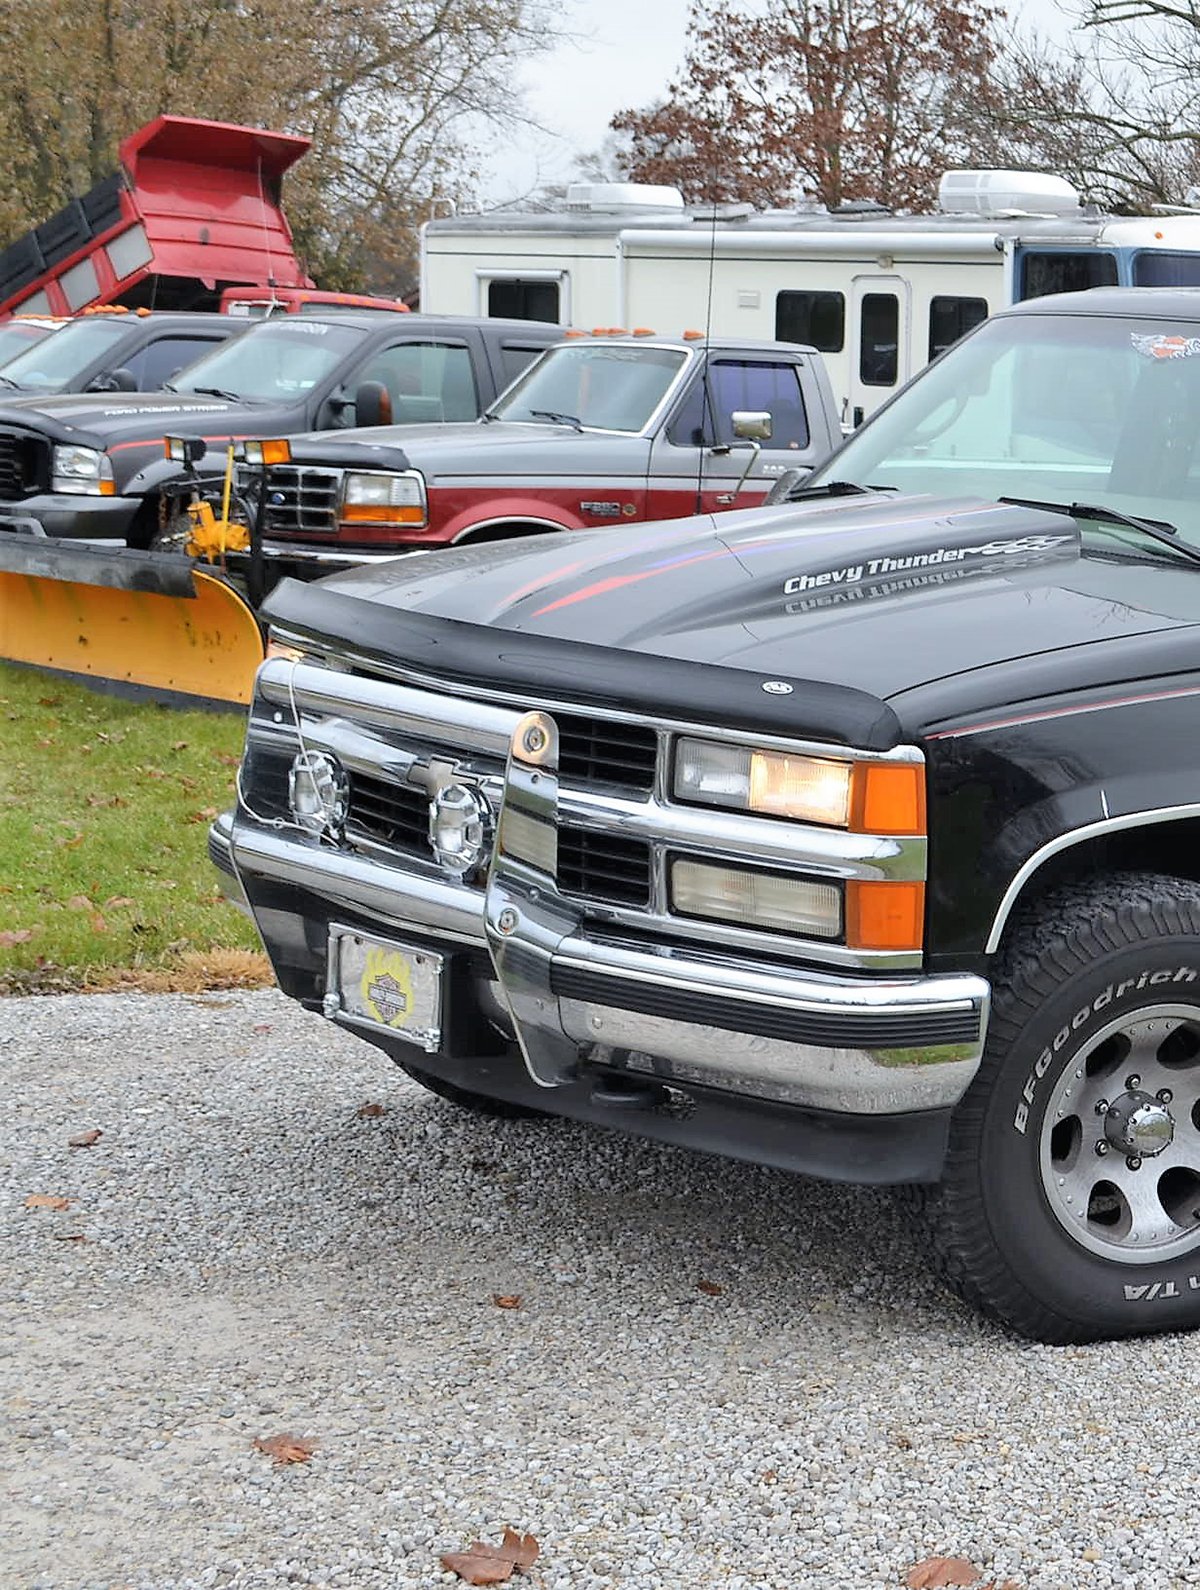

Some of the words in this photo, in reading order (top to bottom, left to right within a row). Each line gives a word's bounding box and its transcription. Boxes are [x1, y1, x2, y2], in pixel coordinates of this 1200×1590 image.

[784, 565, 864, 595] Chevy
[867, 548, 968, 574] Thunder
[1013, 966, 1198, 1134] BFGoodrich
[1123, 1280, 1181, 1301] T/A
